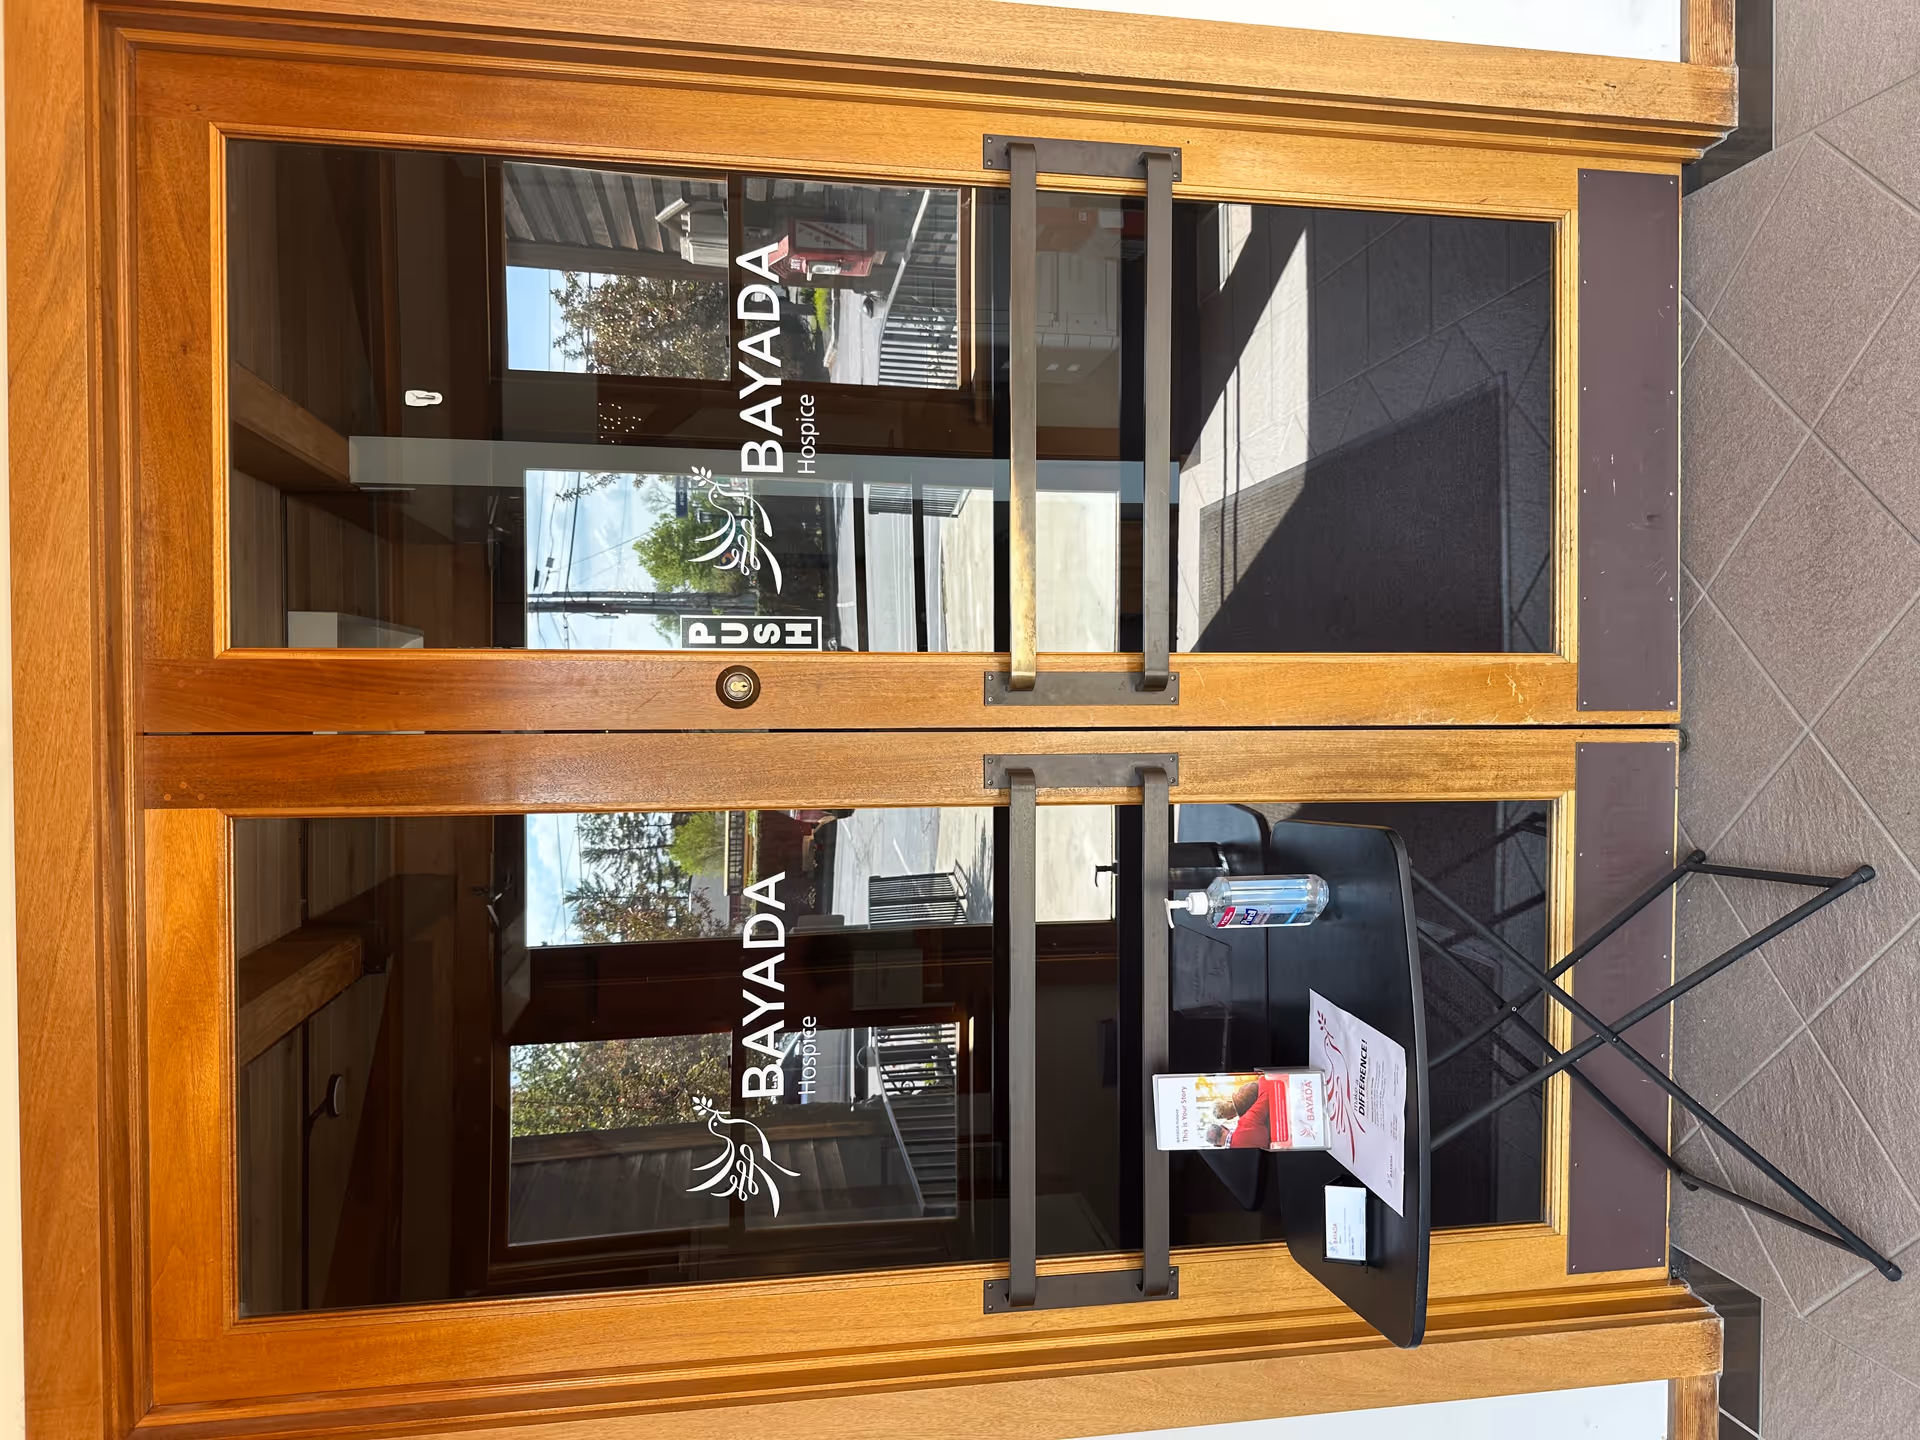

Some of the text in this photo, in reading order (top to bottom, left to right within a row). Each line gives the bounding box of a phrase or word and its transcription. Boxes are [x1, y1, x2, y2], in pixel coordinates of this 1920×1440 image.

[736, 243, 783, 472] BAYADA
[796, 395, 820, 474] Hospice
[688, 623, 812, 644] PUSH
[742, 871, 785, 1098] BAYADA
[797, 1016, 822, 1094] Hospice
[1358, 1039, 1367, 1116] DIFFERENCE!
[1304, 1081, 1315, 1121] BAYADA
